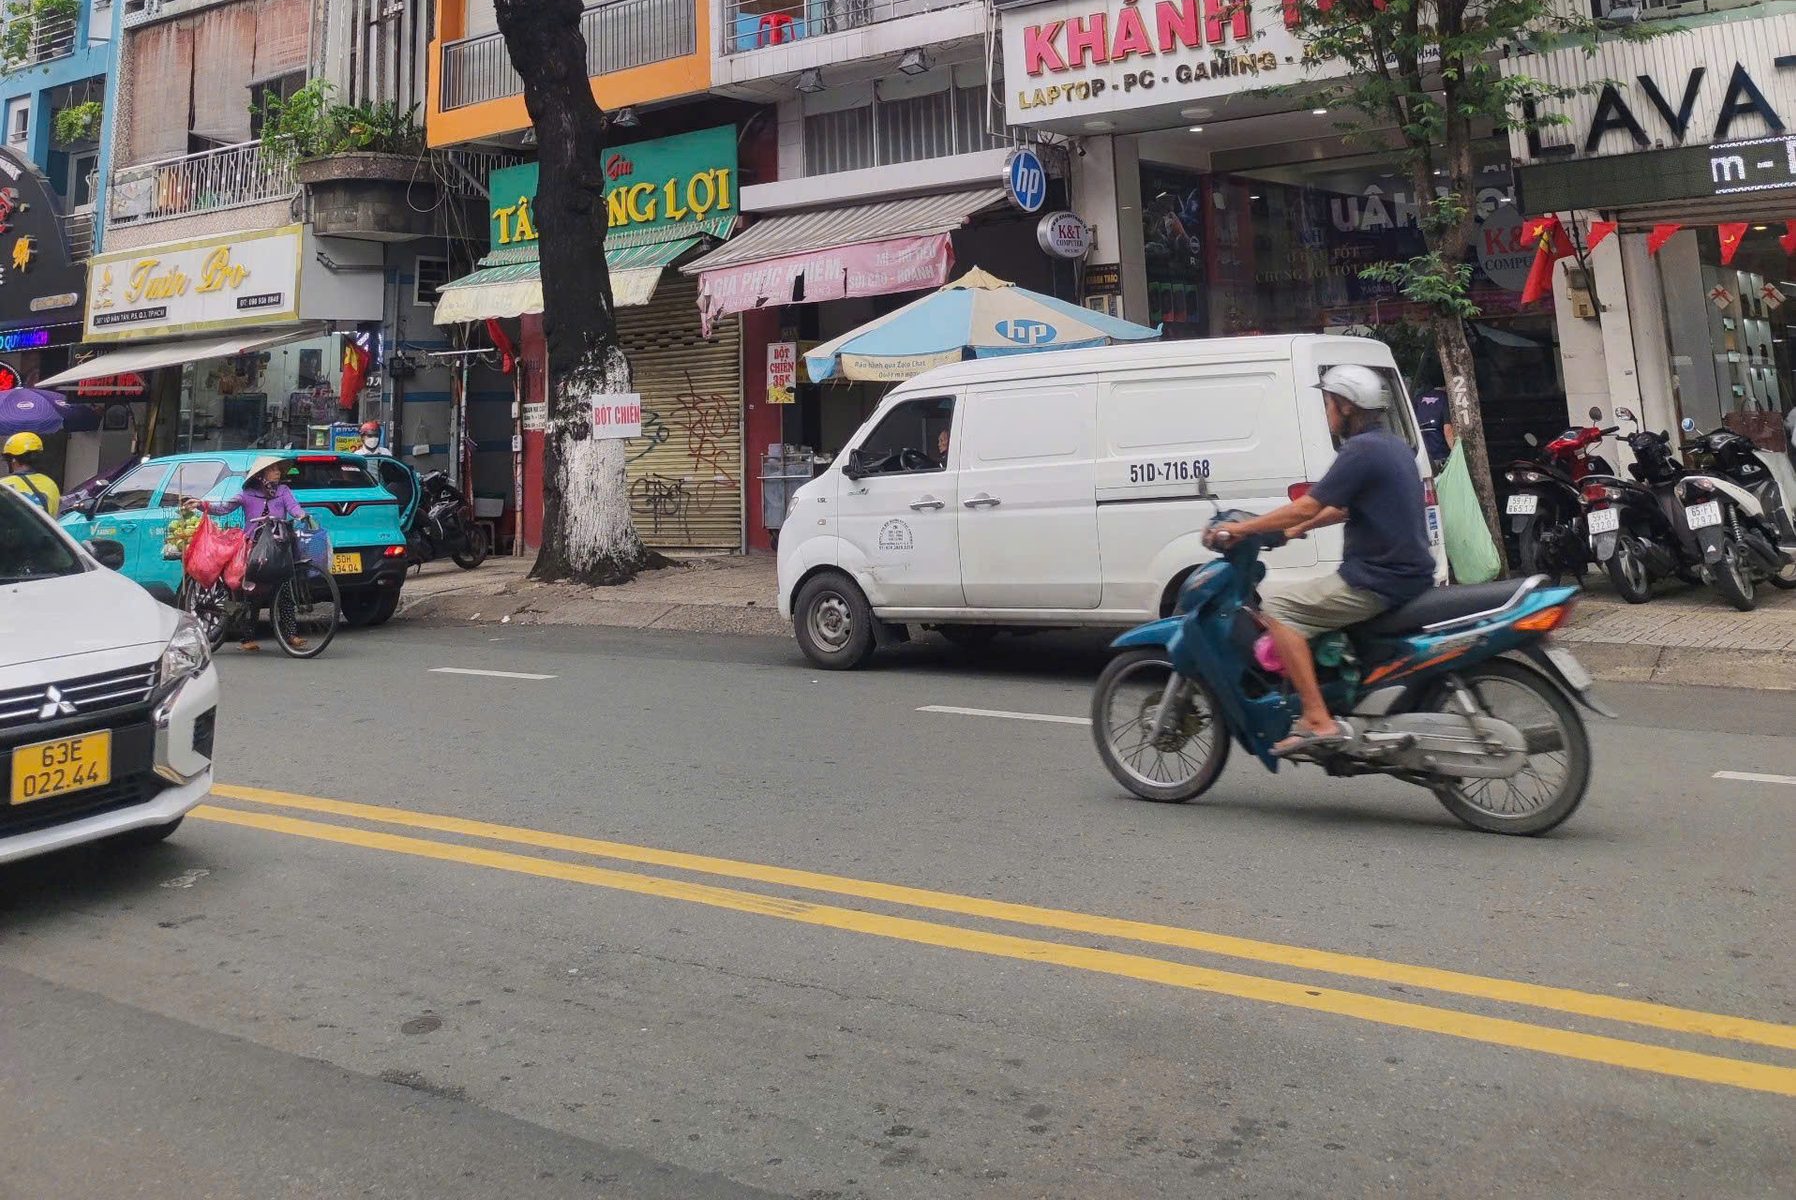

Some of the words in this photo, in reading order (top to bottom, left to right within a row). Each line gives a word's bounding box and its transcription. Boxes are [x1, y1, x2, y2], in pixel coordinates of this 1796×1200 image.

[1018, 78, 1105, 110] LAPTOP
[1123, 69, 1155, 93] PC
[1175, 51, 1277, 84] GAMING
[1522, 54, 1796, 159] LAVA
[1016, 153, 1040, 209] hp
[606, 182, 656, 228] NG
[663, 168, 732, 222] LỢI
[1056, 239, 1084, 247] COMPUTER
[1058, 225, 1081, 240] K&T
[1485, 257, 1534, 272] COMPU
[1007, 319, 1047, 345] hp
[594, 404, 612, 429] BỘT
[1452, 375, 1470, 425] 241
[42, 739, 83, 768] 63E
[23, 760, 99, 797] 022.44
